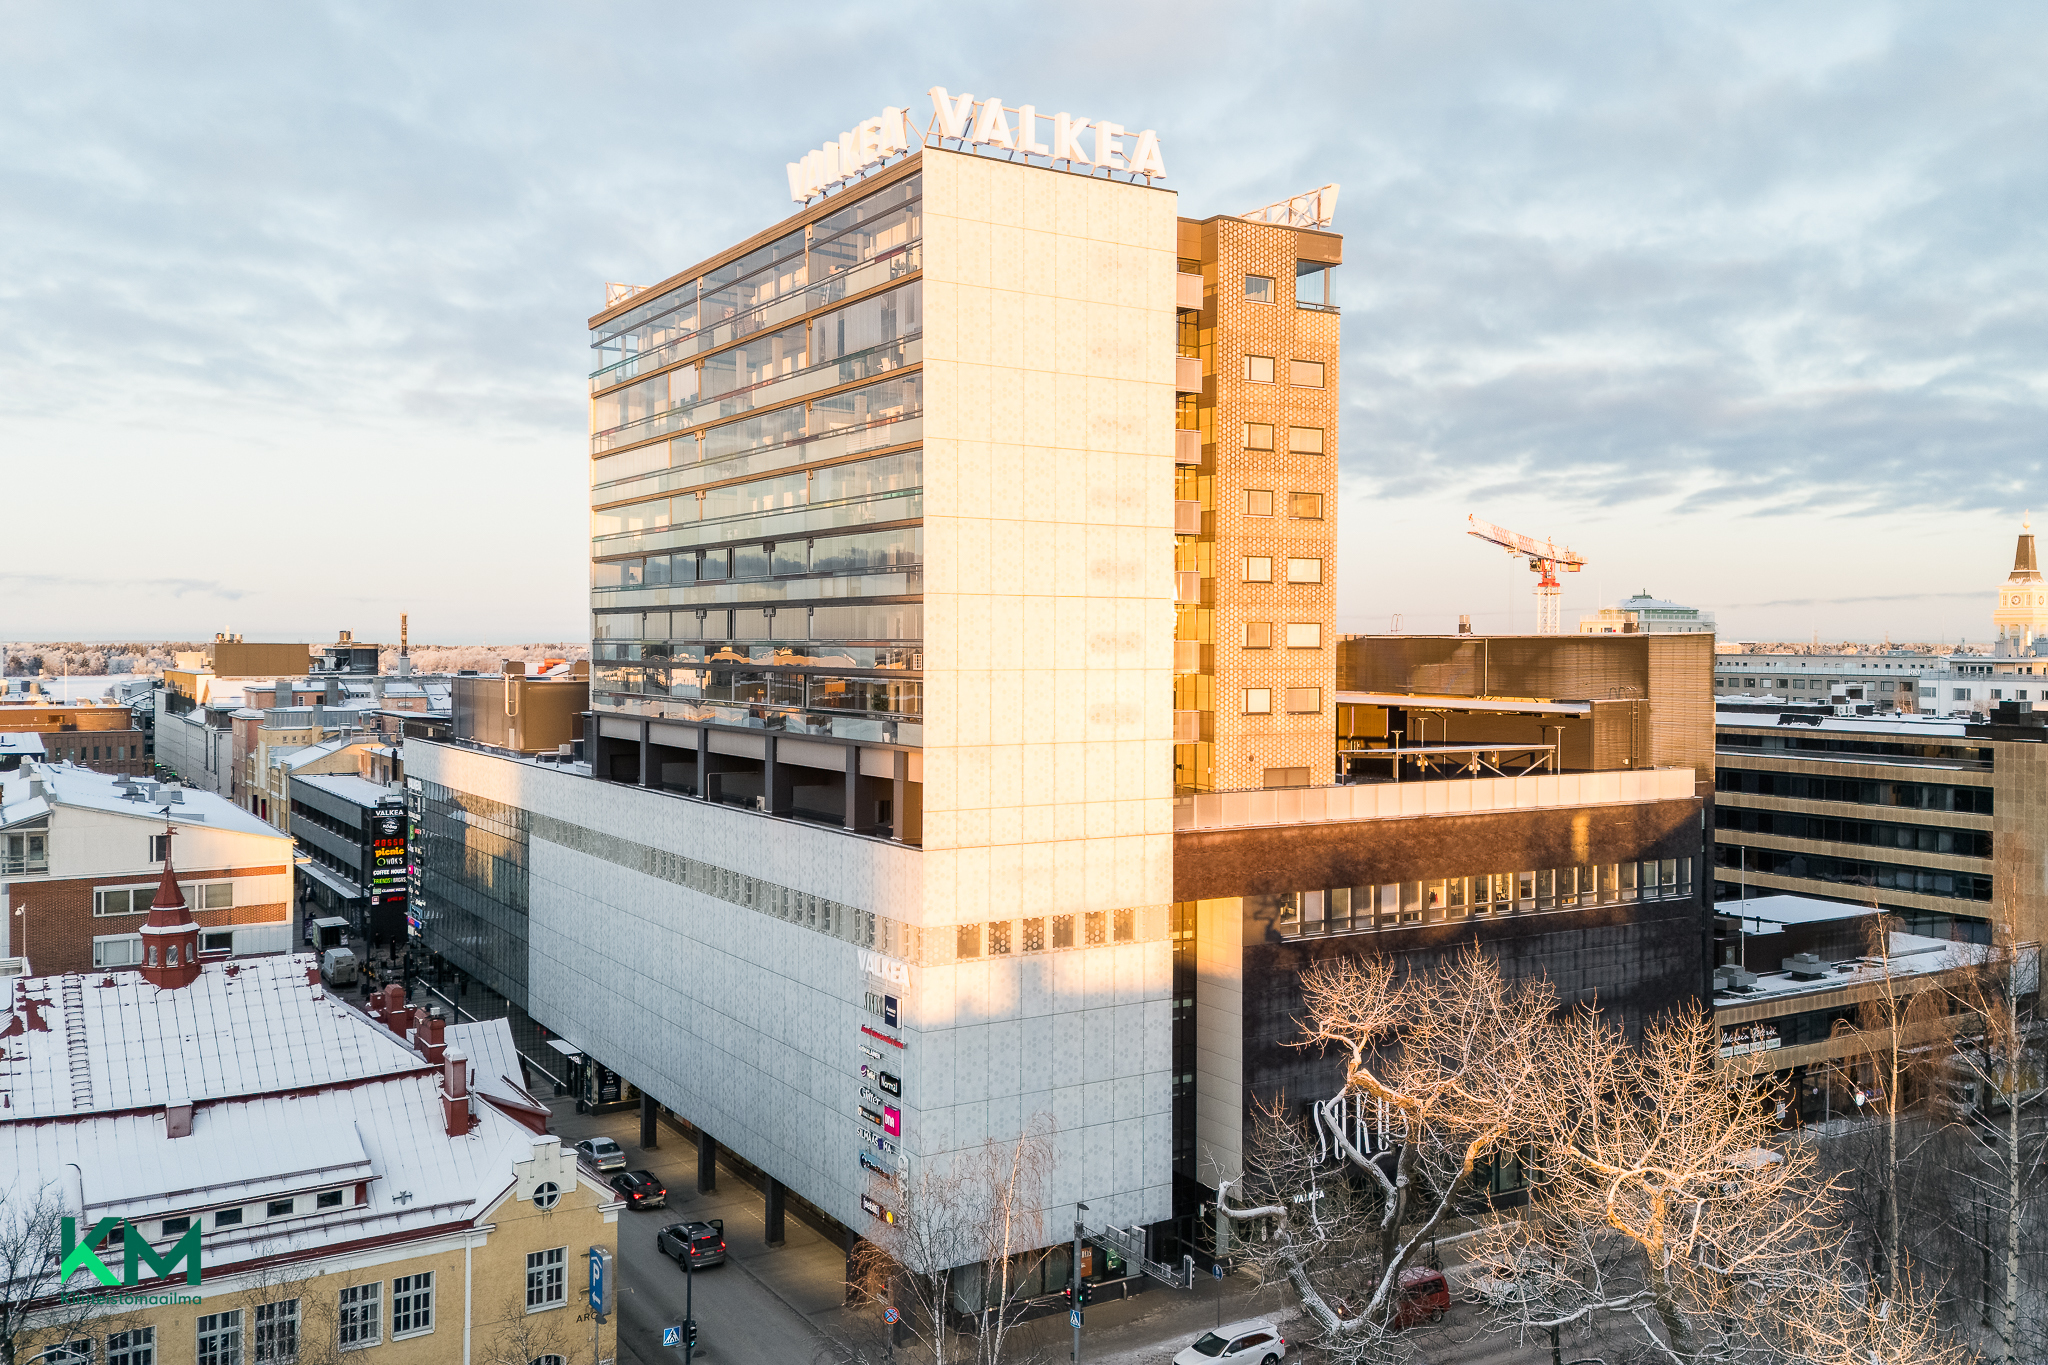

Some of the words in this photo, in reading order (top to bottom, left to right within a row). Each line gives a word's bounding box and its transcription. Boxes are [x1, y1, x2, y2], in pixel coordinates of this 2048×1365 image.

[929, 86, 1167, 179] VALKEA
[786, 106, 908, 204] VALKEA
[374, 838, 404, 847] ROSSO
[375, 846, 405, 857] picnic
[857, 948, 910, 987] VALKEA
[880, 1075, 898, 1094] Normal
[858, 1086, 881, 1106] Glitter
[884, 1113, 895, 1128] DNA
[1293, 1190, 1325, 1204] VAKEA
[592, 1262, 600, 1287] P
